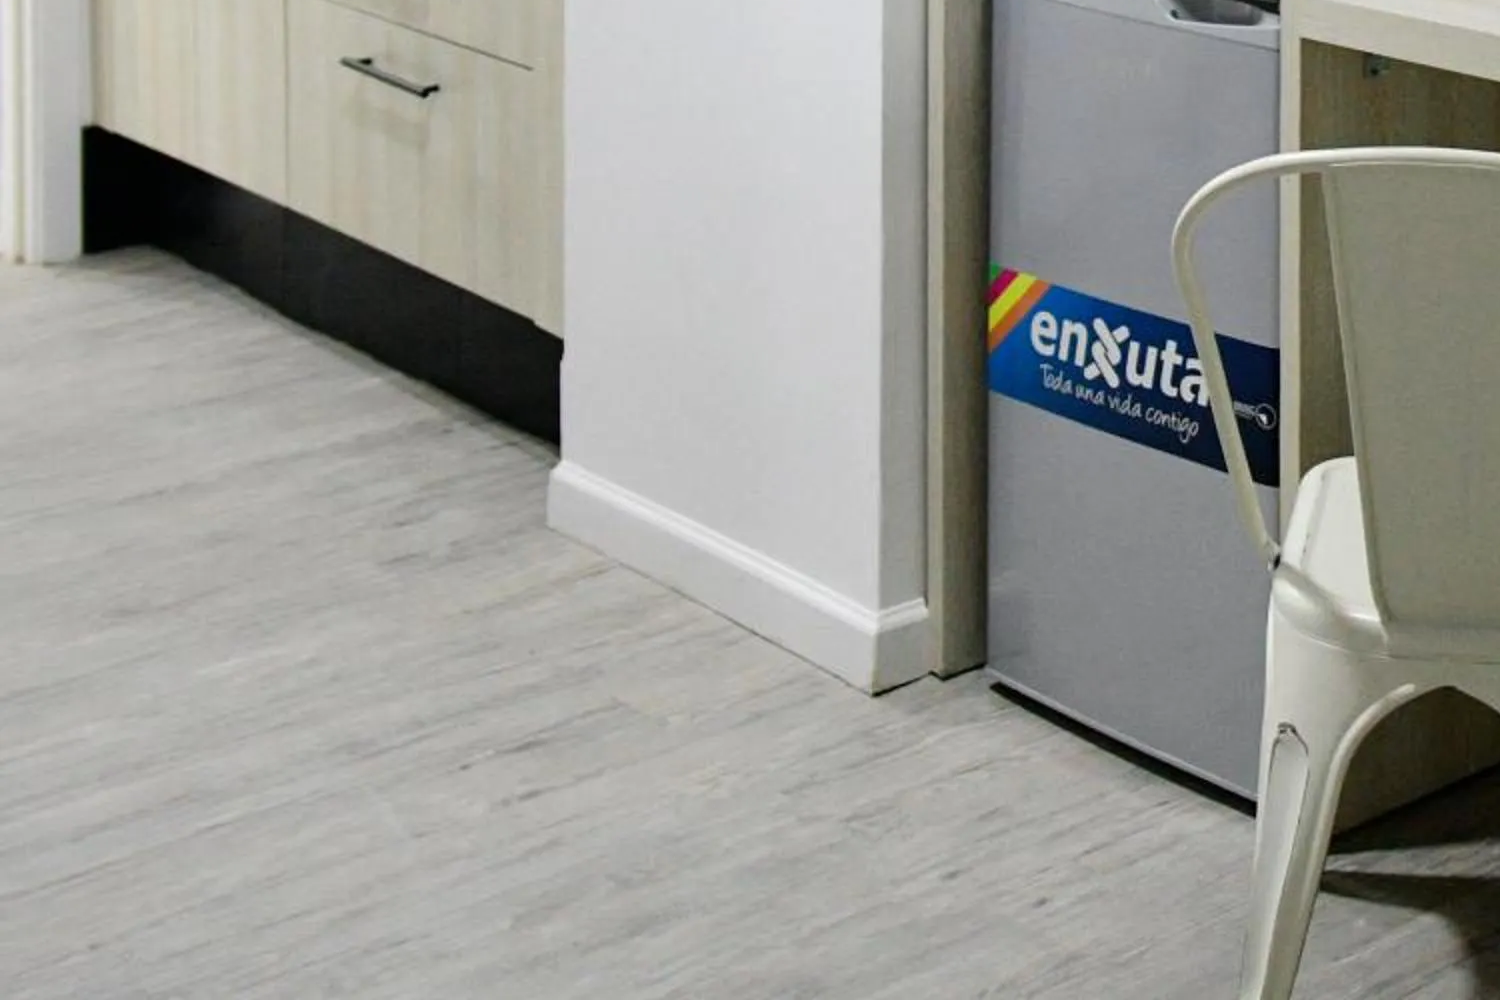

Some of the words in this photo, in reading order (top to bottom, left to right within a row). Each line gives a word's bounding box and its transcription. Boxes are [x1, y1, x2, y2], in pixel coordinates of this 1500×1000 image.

[1039, 363, 1073, 395] Toda
[1075, 384, 1105, 406] una
[1107, 392, 1142, 419] vida
[1145, 406, 1199, 444] contigo
